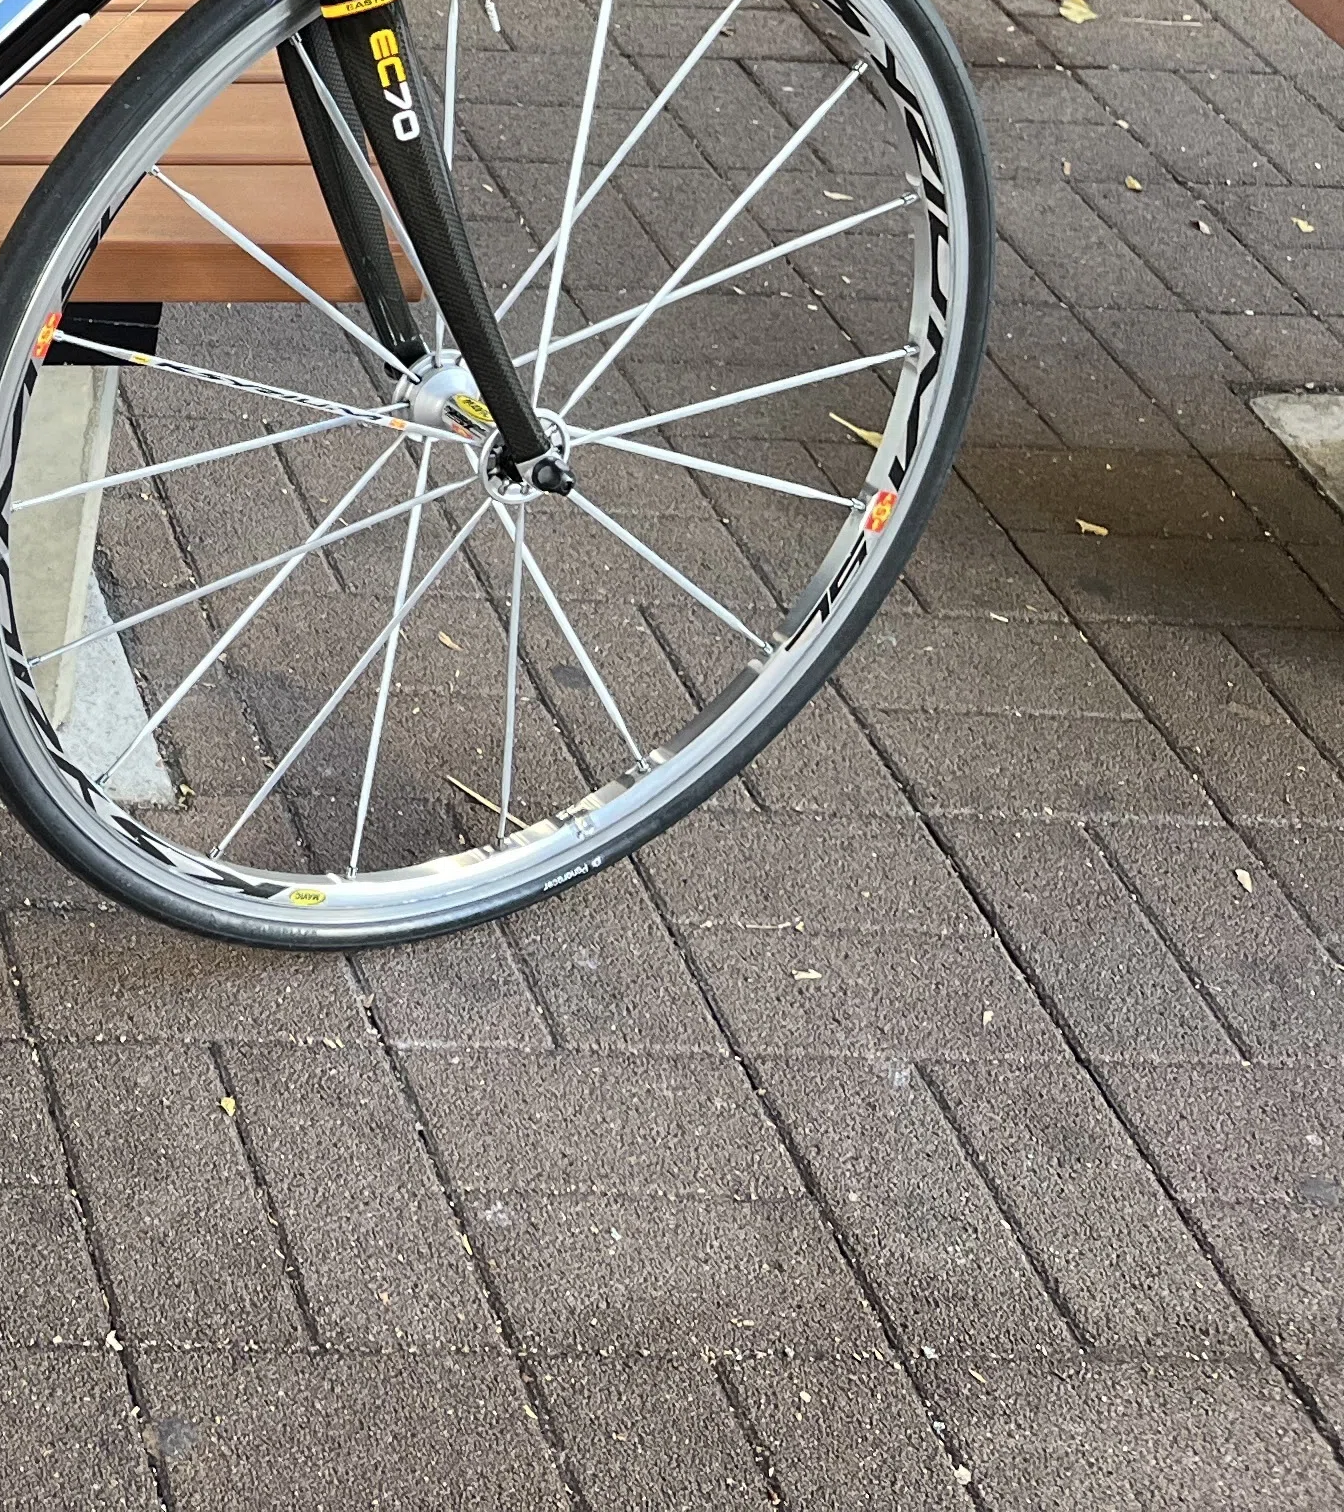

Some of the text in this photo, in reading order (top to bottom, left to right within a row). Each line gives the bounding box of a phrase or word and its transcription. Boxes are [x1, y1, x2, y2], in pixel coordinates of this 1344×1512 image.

[370, 28, 420, 152] EC70
[543, 862, 589, 892] Panaracer
[295, 891, 320, 902] MAVIC
